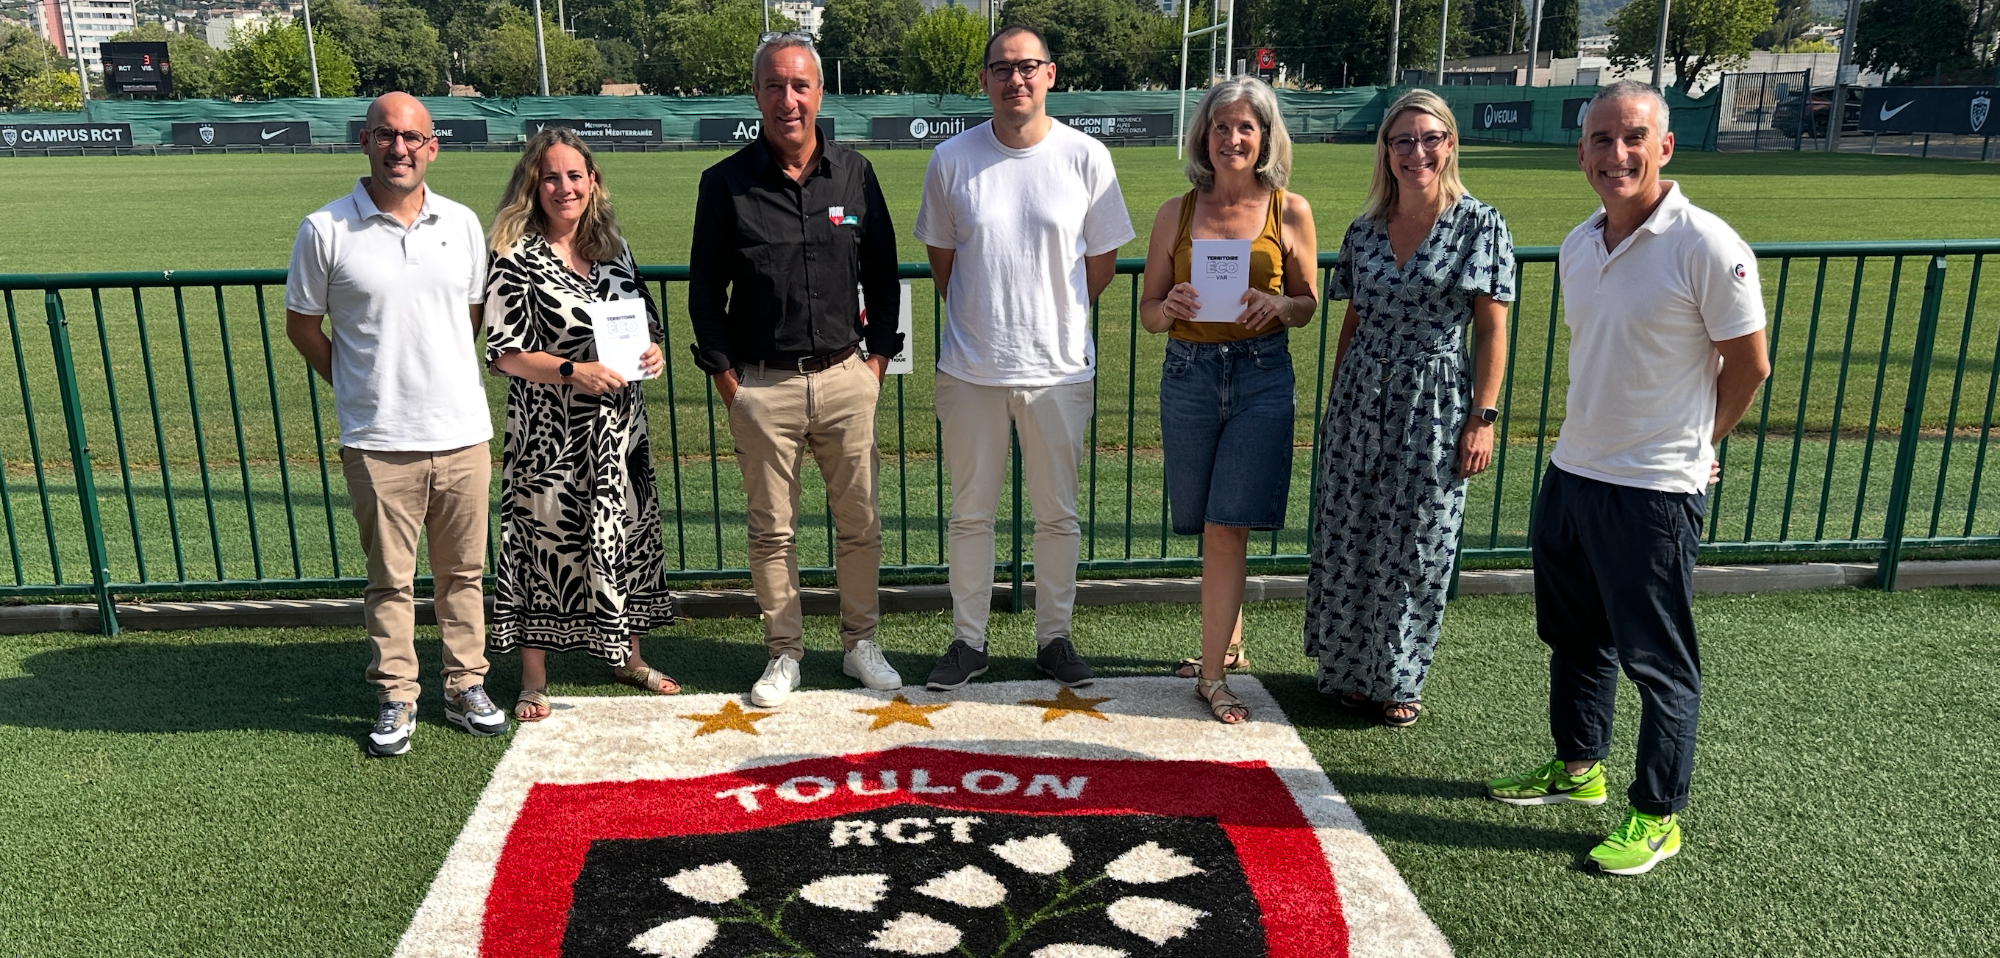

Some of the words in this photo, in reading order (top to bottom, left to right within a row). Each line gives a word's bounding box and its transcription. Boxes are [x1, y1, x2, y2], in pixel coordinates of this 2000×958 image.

[144, 55, 150, 65] 3
[1069, 117, 1101, 126] RÉGION
[1494, 110, 1518, 124] VEOLIA
[21, 129, 89, 142] CAMPUS
[90, 128, 123, 142] RCT
[571, 128, 604, 137] PROVENCE
[1083, 126, 1101, 134] SUD
[714, 768, 1090, 814] TOULON
[829, 815, 985, 849] RCT
